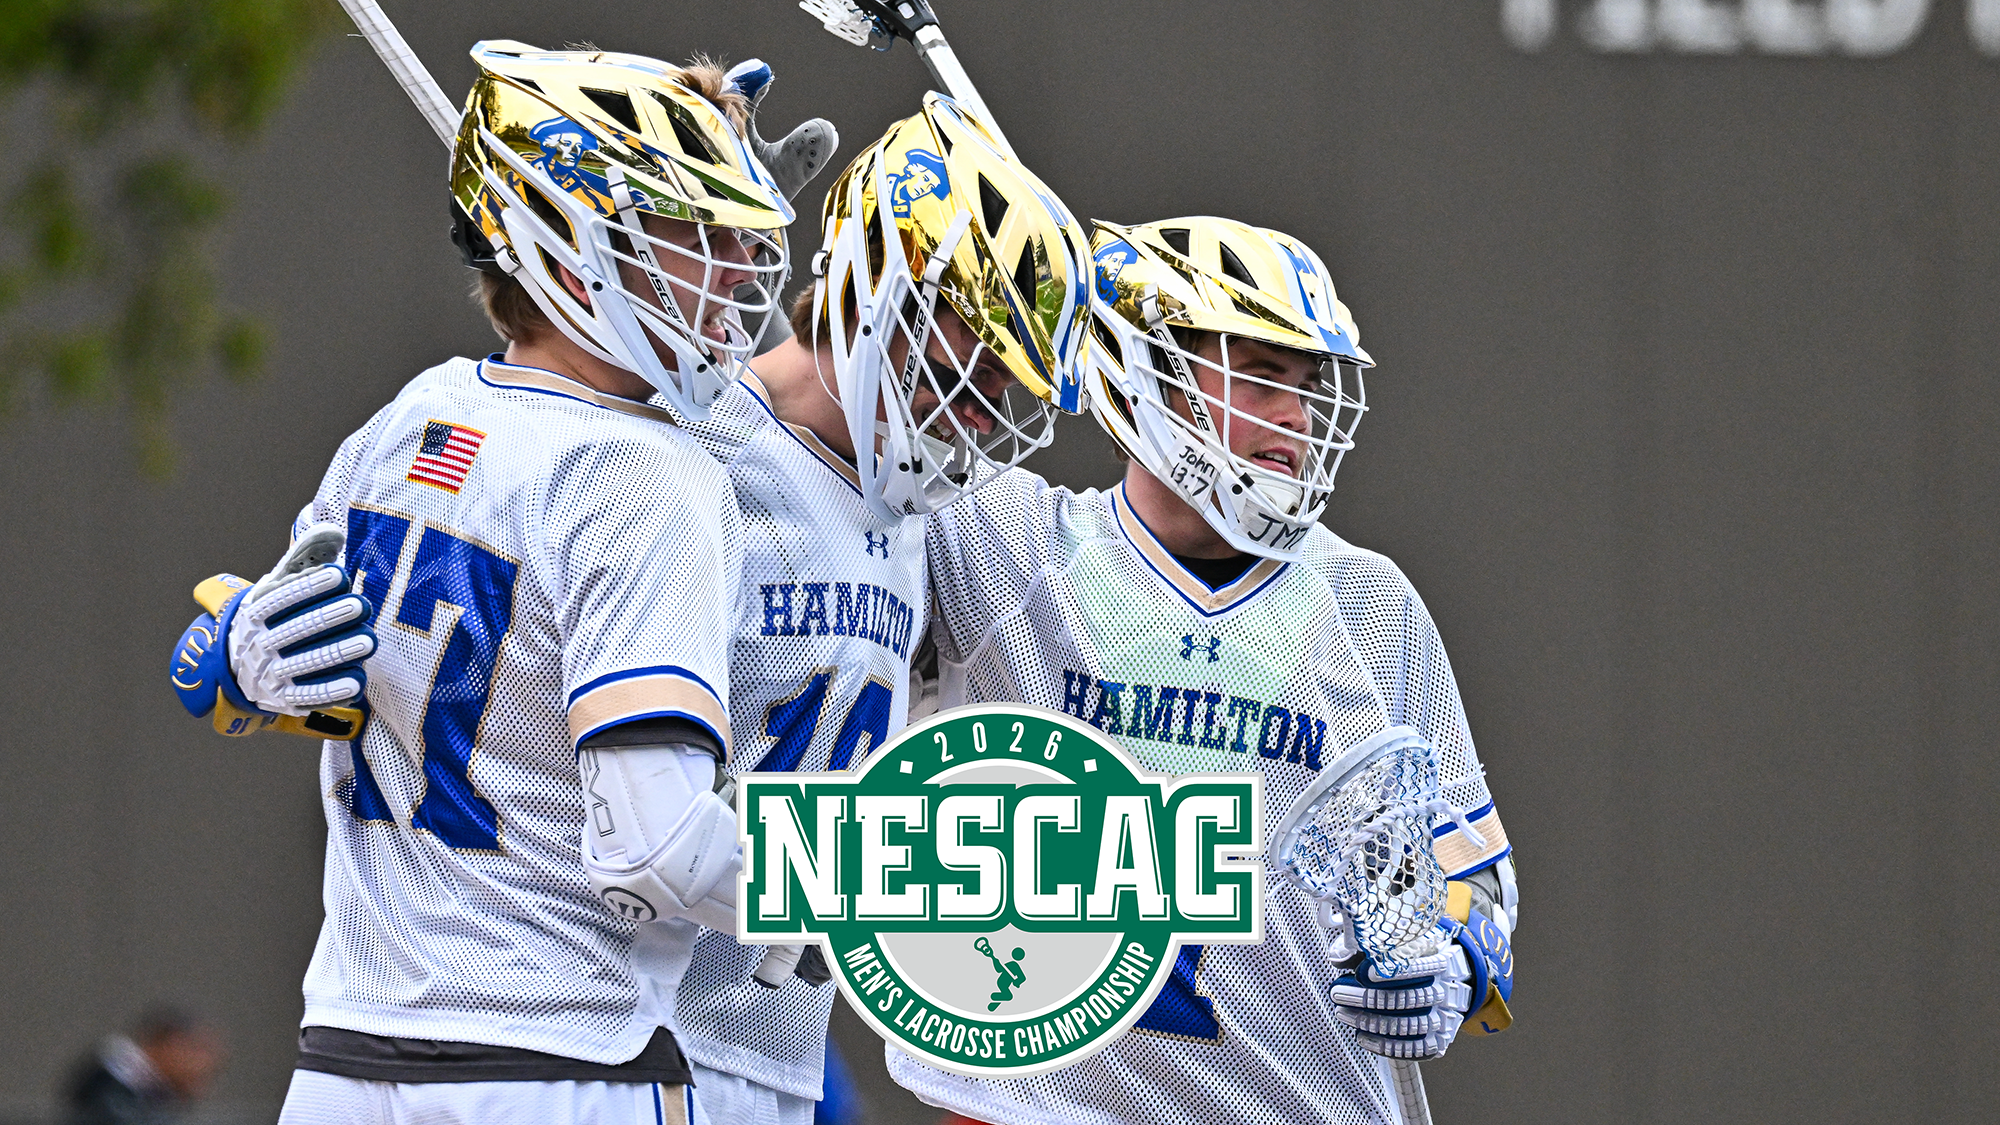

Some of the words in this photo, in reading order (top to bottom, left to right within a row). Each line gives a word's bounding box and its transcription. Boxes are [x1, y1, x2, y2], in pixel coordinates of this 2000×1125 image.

[1170, 462, 1210, 497] 13:7
[1179, 445, 1216, 478] John
[759, 581, 914, 663] HAMILTON
[1063, 669, 1328, 773] HAMILTON
